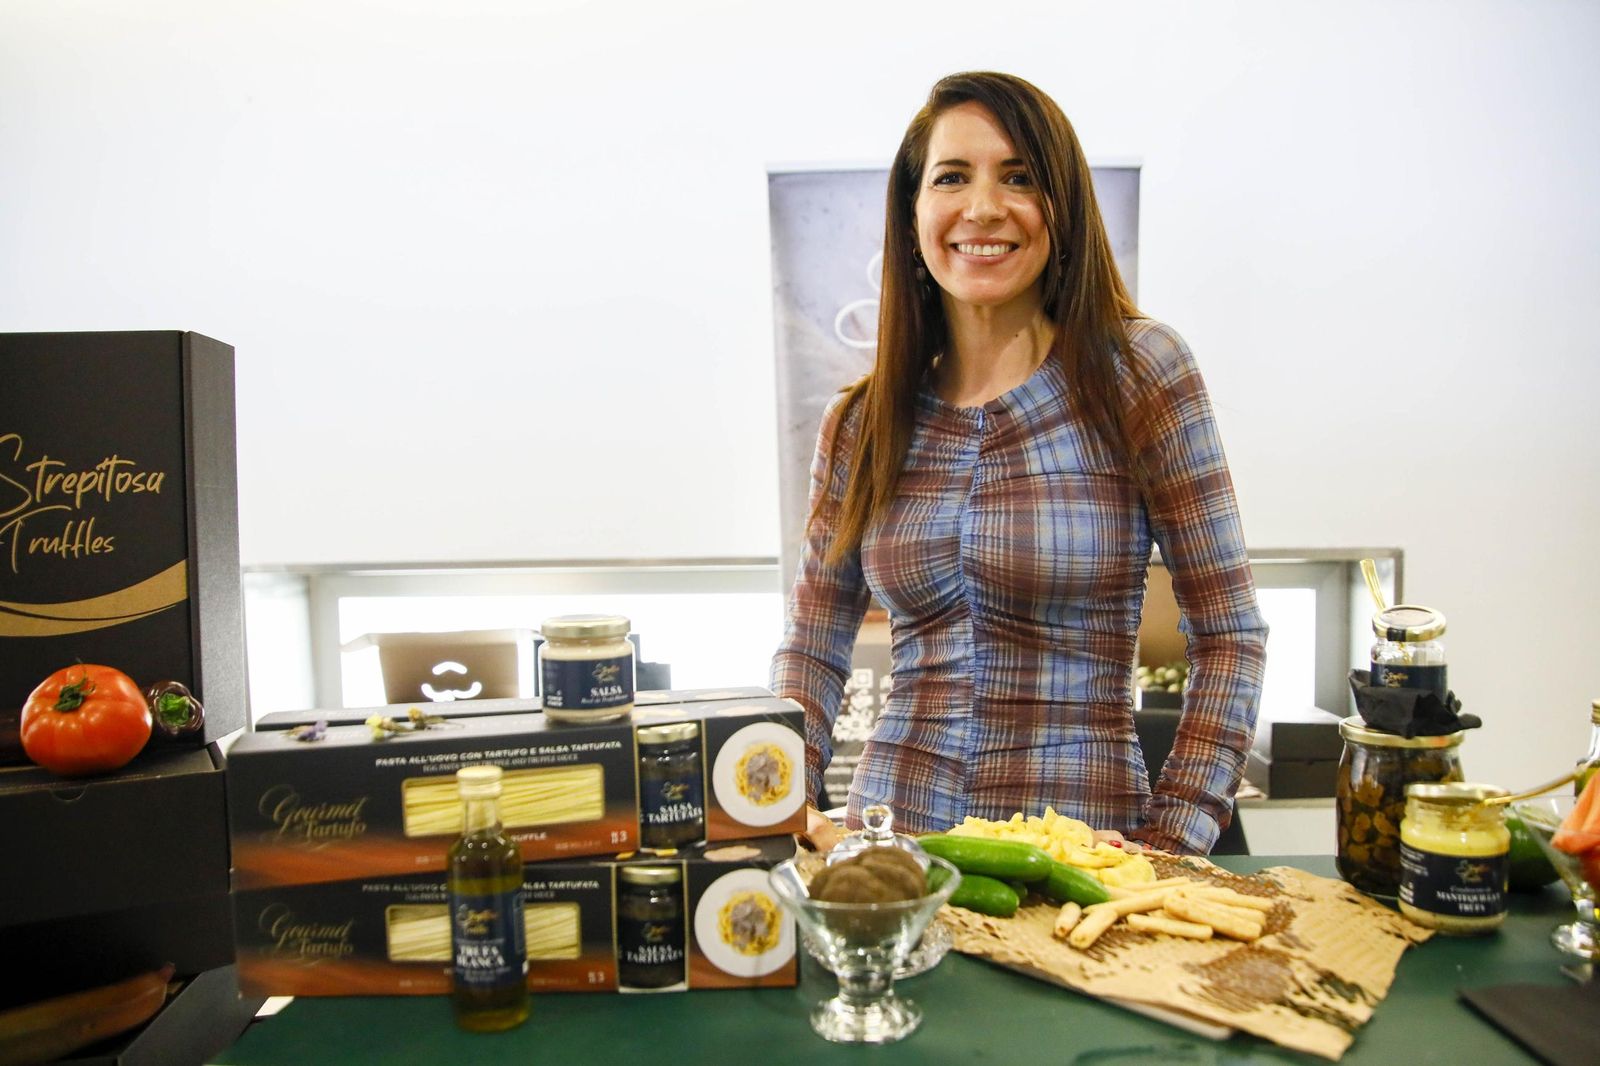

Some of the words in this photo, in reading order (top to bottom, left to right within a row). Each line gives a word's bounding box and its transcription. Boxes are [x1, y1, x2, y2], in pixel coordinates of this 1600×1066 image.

[0, 433, 165, 518] Strepitosa
[0, 505, 115, 574] Truffles
[590, 685, 622, 697] SALSA
[375, 757, 406, 767] PASTA
[460, 751, 482, 760] CON
[484, 748, 528, 758] TARTUFO
[529, 747, 537, 755] E
[538, 744, 569, 754] SALSA
[570, 741, 622, 752] TARTUFATA
[659, 802, 693, 813] SALSA
